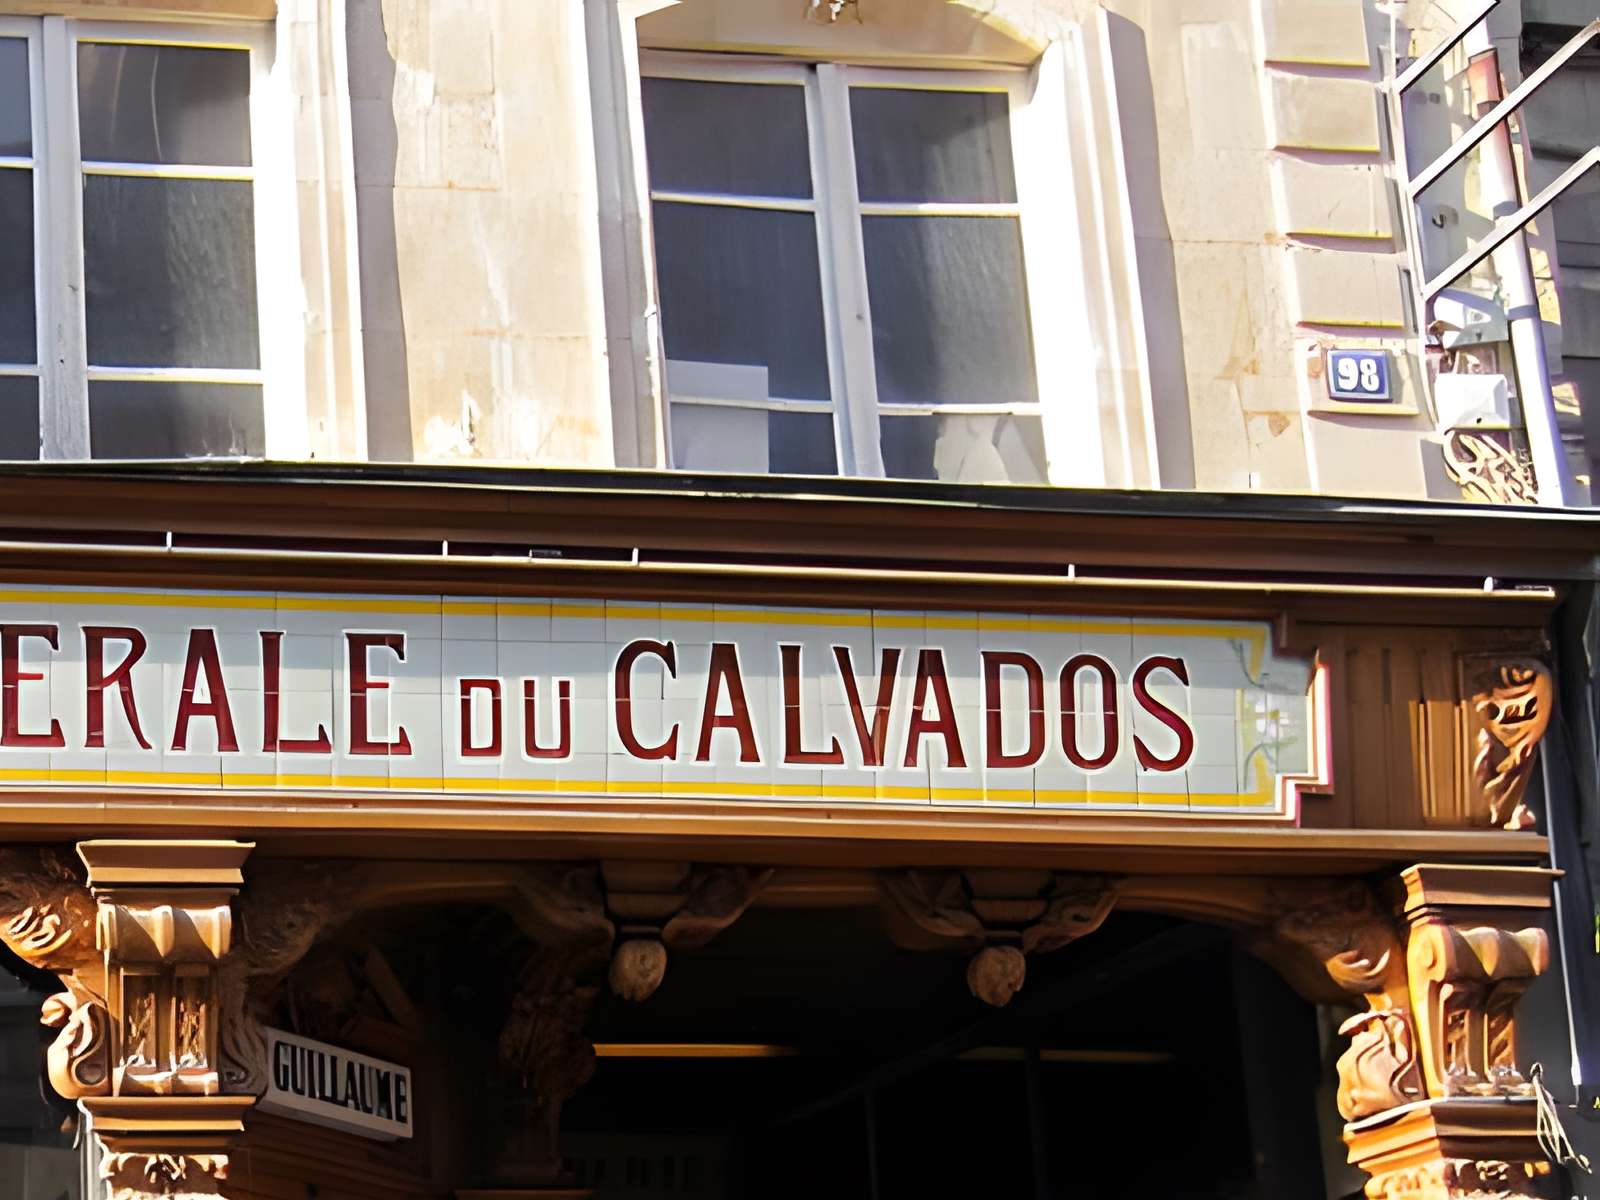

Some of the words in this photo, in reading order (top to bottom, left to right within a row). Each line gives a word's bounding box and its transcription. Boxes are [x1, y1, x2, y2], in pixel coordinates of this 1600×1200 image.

[1336, 357, 1381, 393] 98
[459, 677, 573, 760] DU
[613, 638, 1196, 773] CALVADOS
[273, 1040, 409, 1124] GUILLAUME
